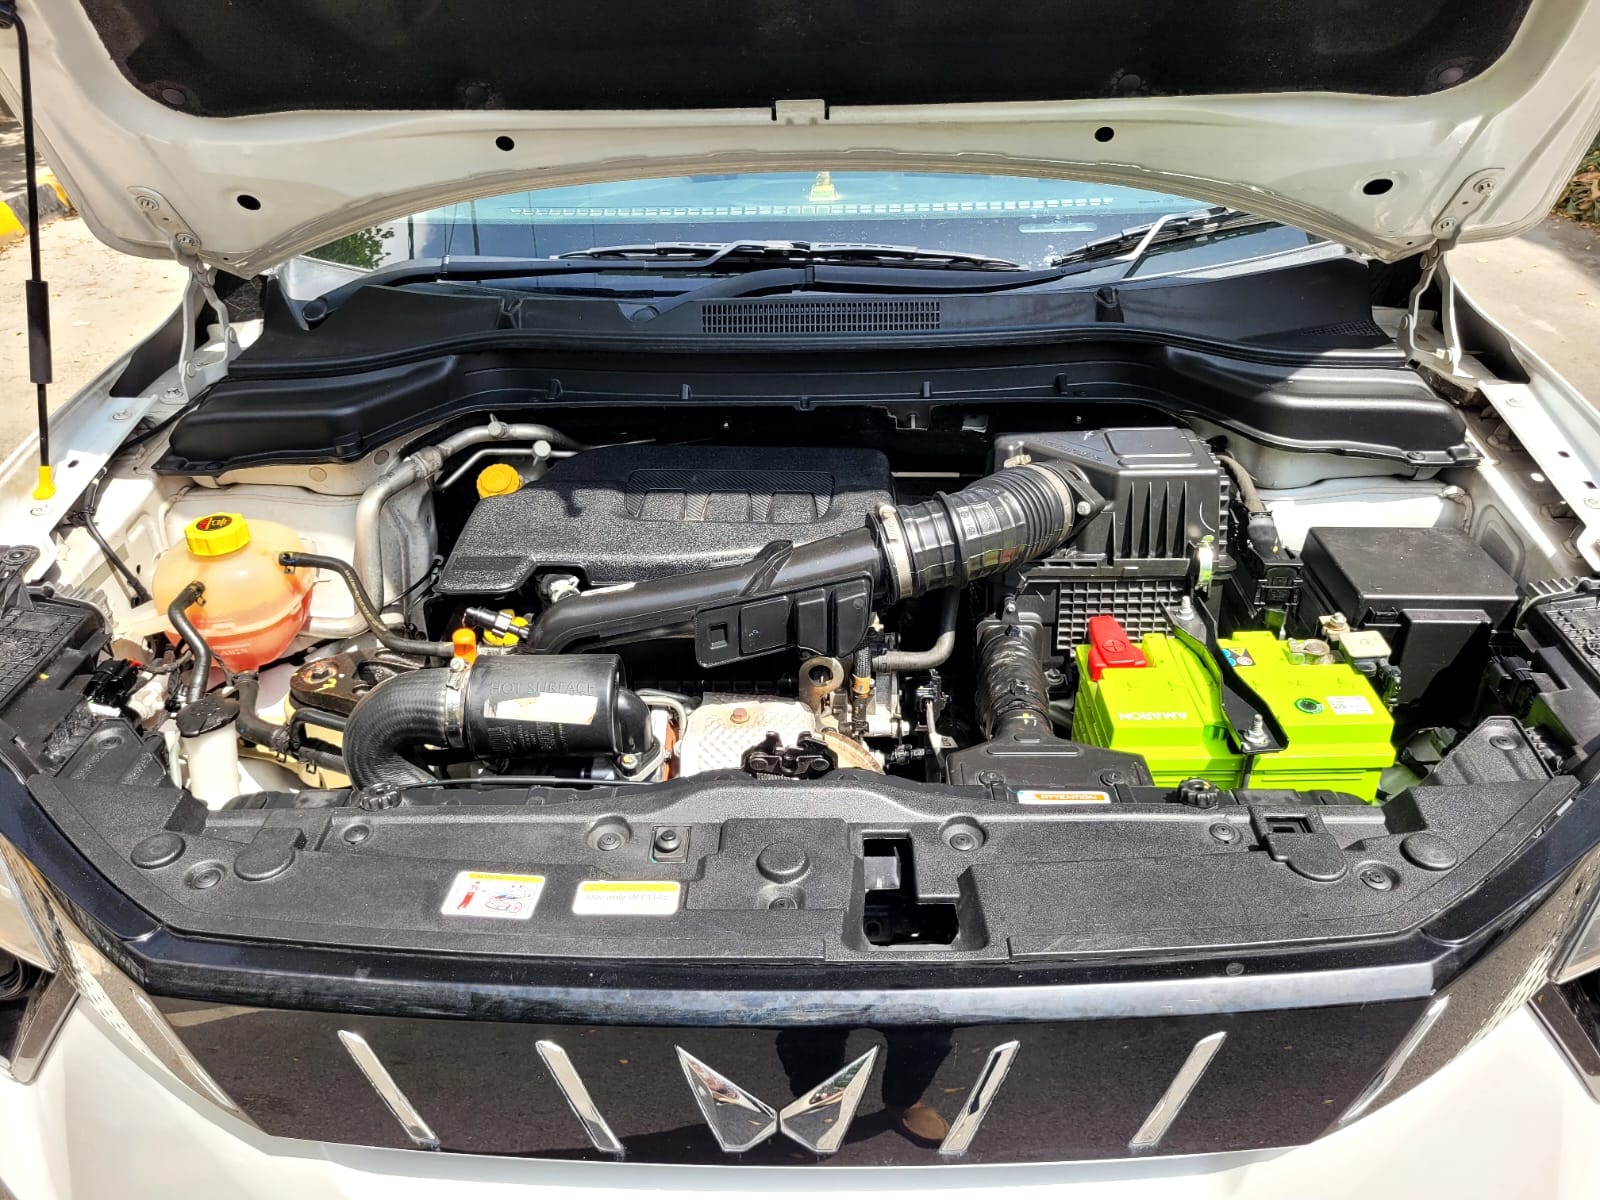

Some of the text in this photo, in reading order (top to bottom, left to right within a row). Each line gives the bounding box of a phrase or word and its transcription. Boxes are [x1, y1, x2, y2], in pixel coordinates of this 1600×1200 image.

[490, 680, 595, 696] HOT SURFACE
[1116, 711, 1187, 721] AMARON
